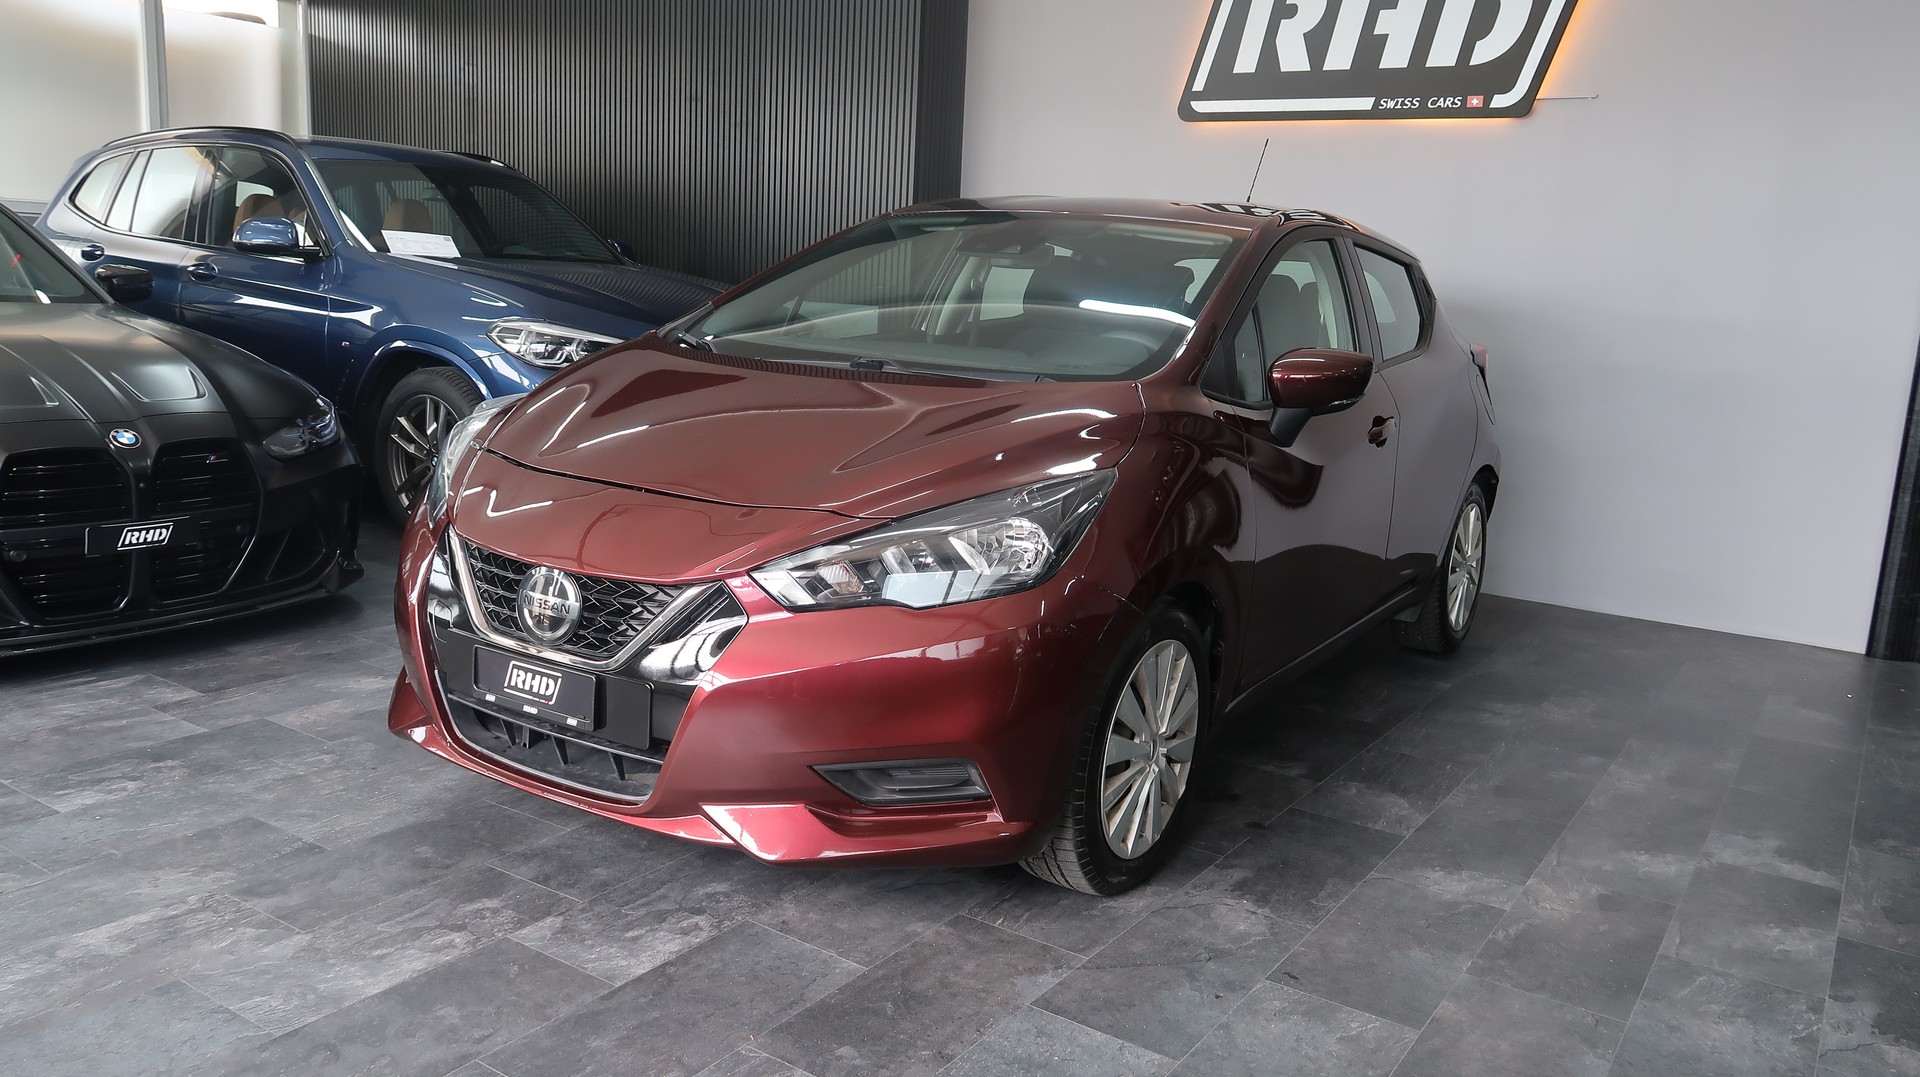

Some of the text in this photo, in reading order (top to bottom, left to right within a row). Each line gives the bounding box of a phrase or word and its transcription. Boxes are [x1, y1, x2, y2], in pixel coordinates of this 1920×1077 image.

[1232, 0, 1532, 74] RHD
[1378, 96, 1462, 109] SWISS CARS
[124, 528, 167, 545] RHD
[523, 594, 571, 615] NISSAN
[511, 668, 556, 696] RHD
